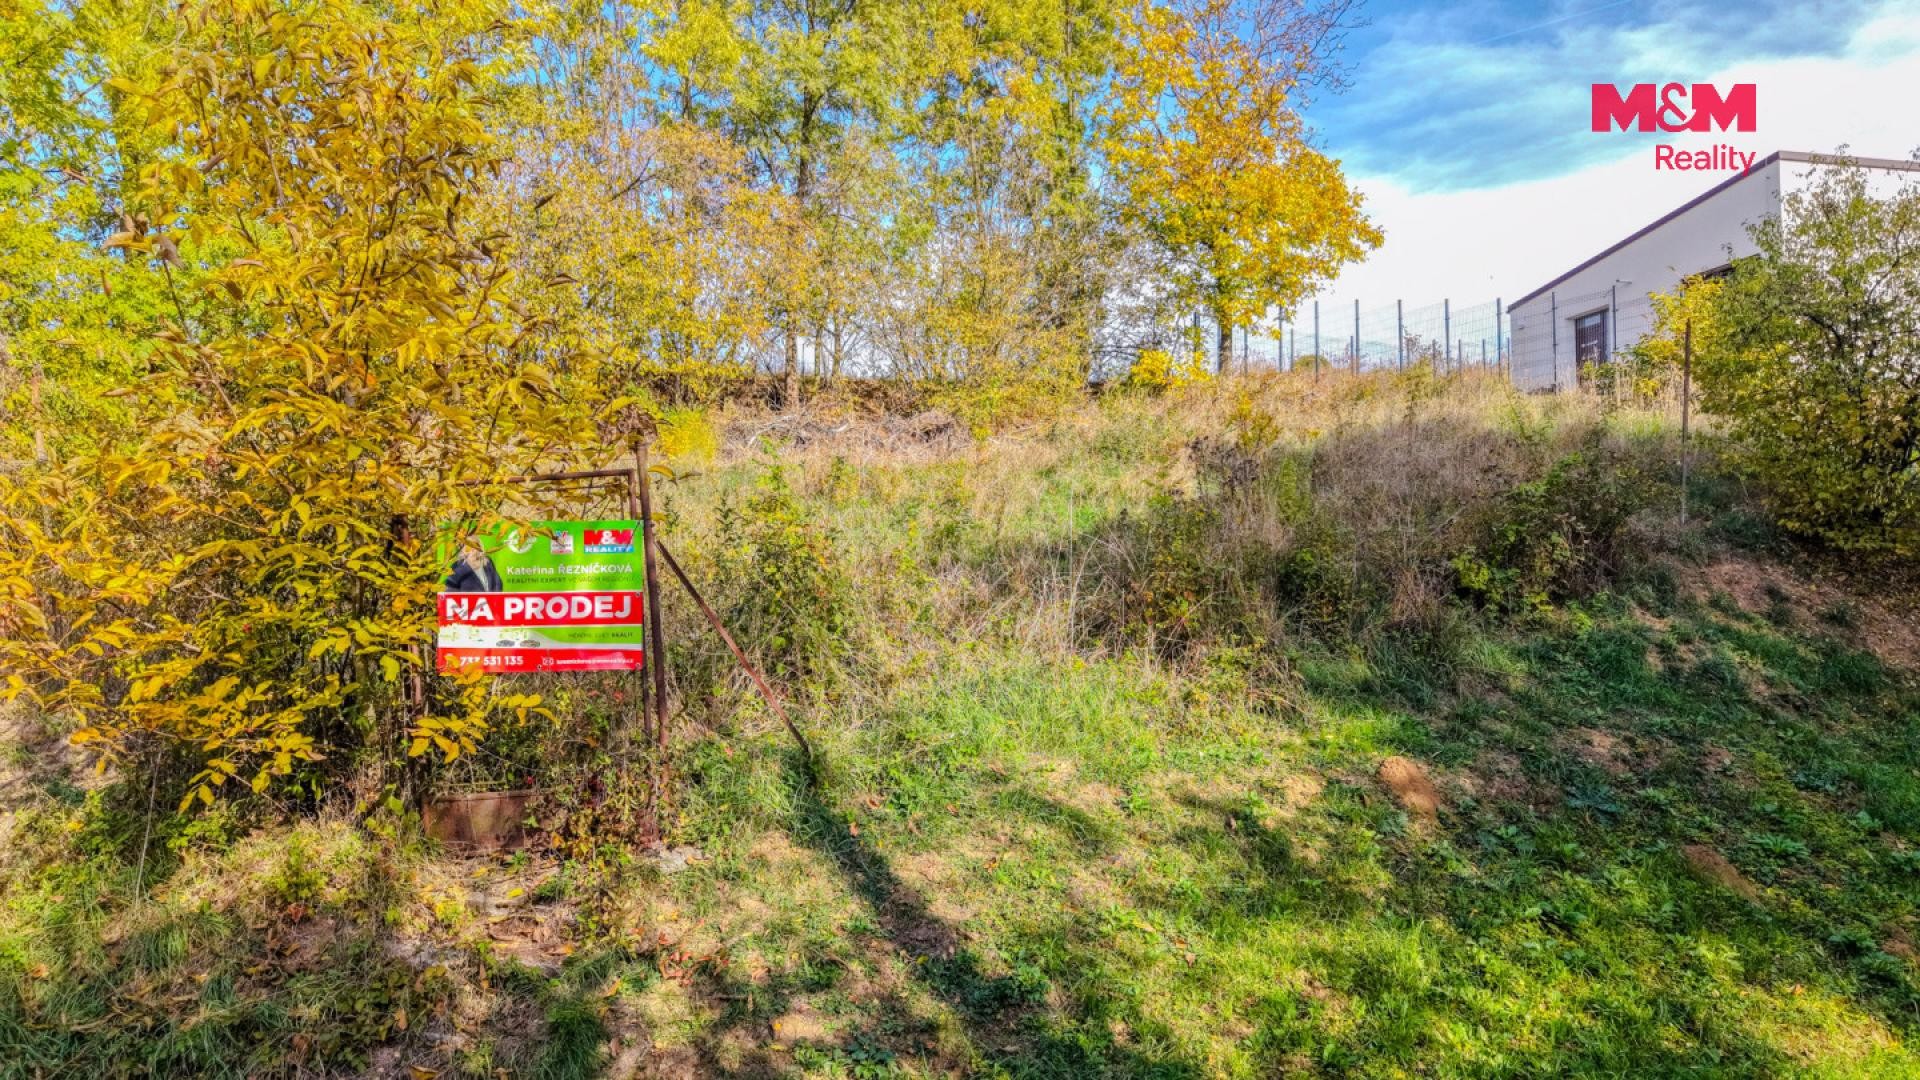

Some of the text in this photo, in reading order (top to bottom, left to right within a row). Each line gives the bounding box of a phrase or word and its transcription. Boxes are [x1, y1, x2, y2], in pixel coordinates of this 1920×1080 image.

[584, 529, 634, 545] M&M
[585, 545, 633, 553] REALITY
[507, 562, 633, 576] Kateřina ŘEZNÍČKOVÁ
[446, 595, 632, 621] NA PRODEJ
[483, 656, 501, 666] 531
[505, 655, 523, 665] 135
